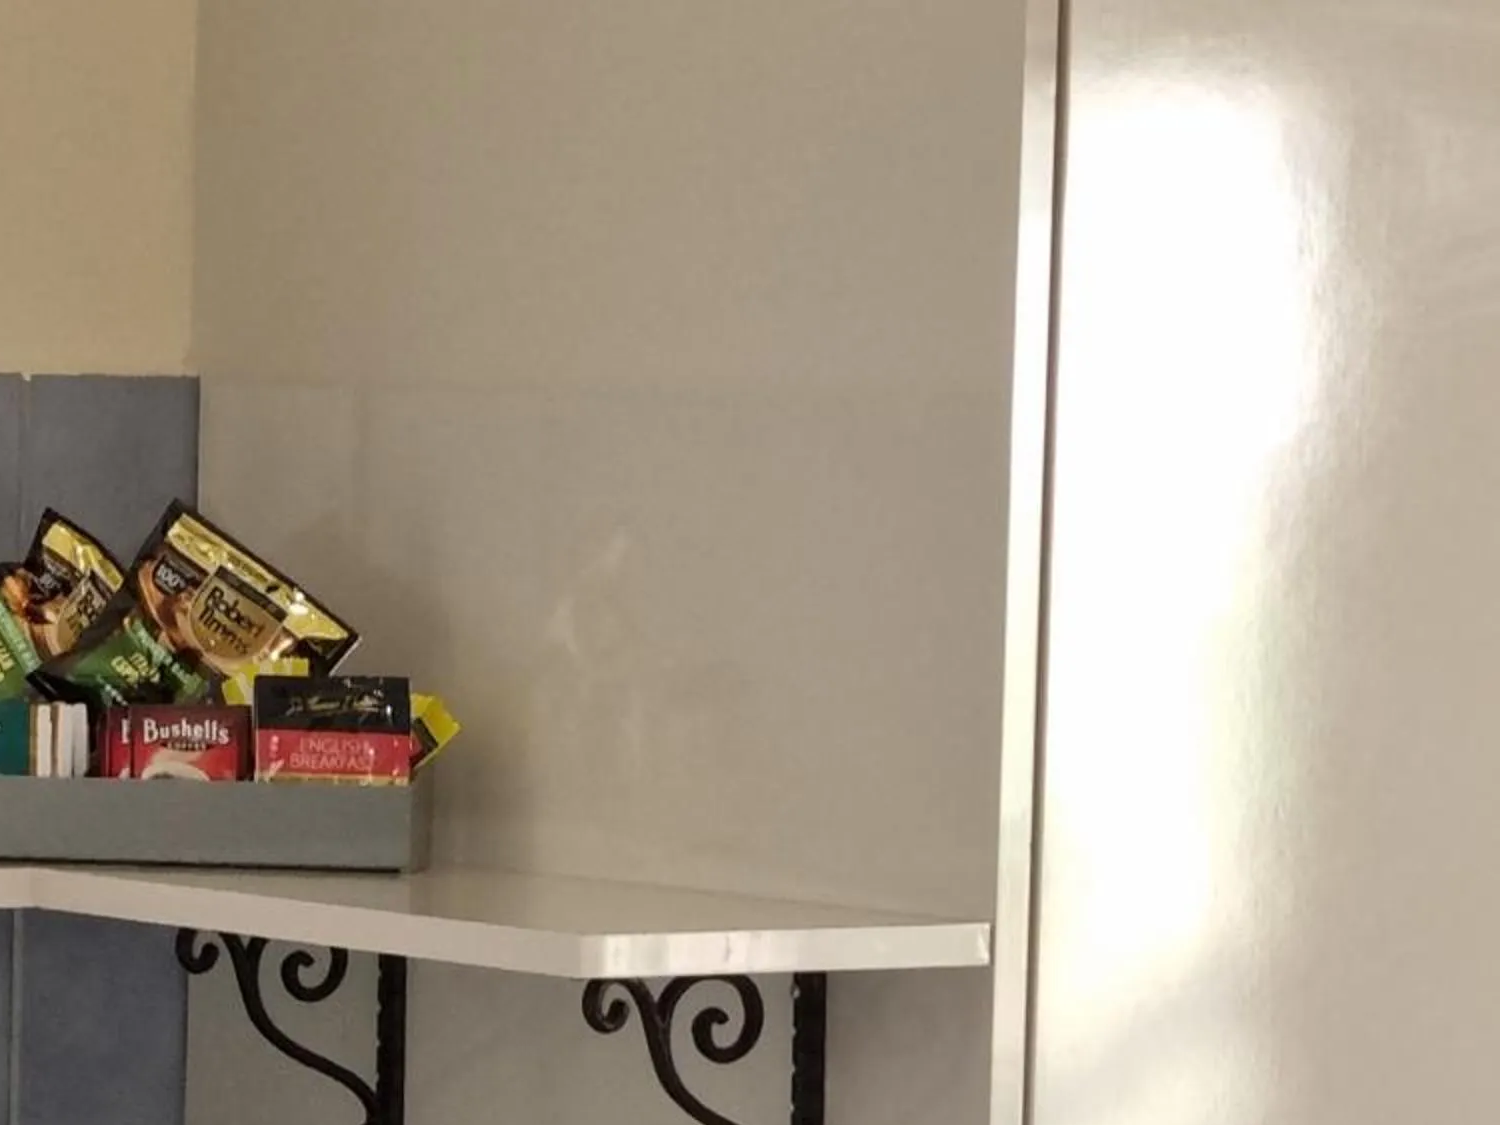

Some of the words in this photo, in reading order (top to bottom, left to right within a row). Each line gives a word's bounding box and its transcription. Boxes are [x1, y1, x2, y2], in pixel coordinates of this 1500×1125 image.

[203, 586, 266, 638] Robert
[198, 607, 248, 656] Timms
[143, 717, 230, 745] Bushells
[300, 736, 370, 752] ENGLISH
[289, 752, 374, 771] BREAKFAST
